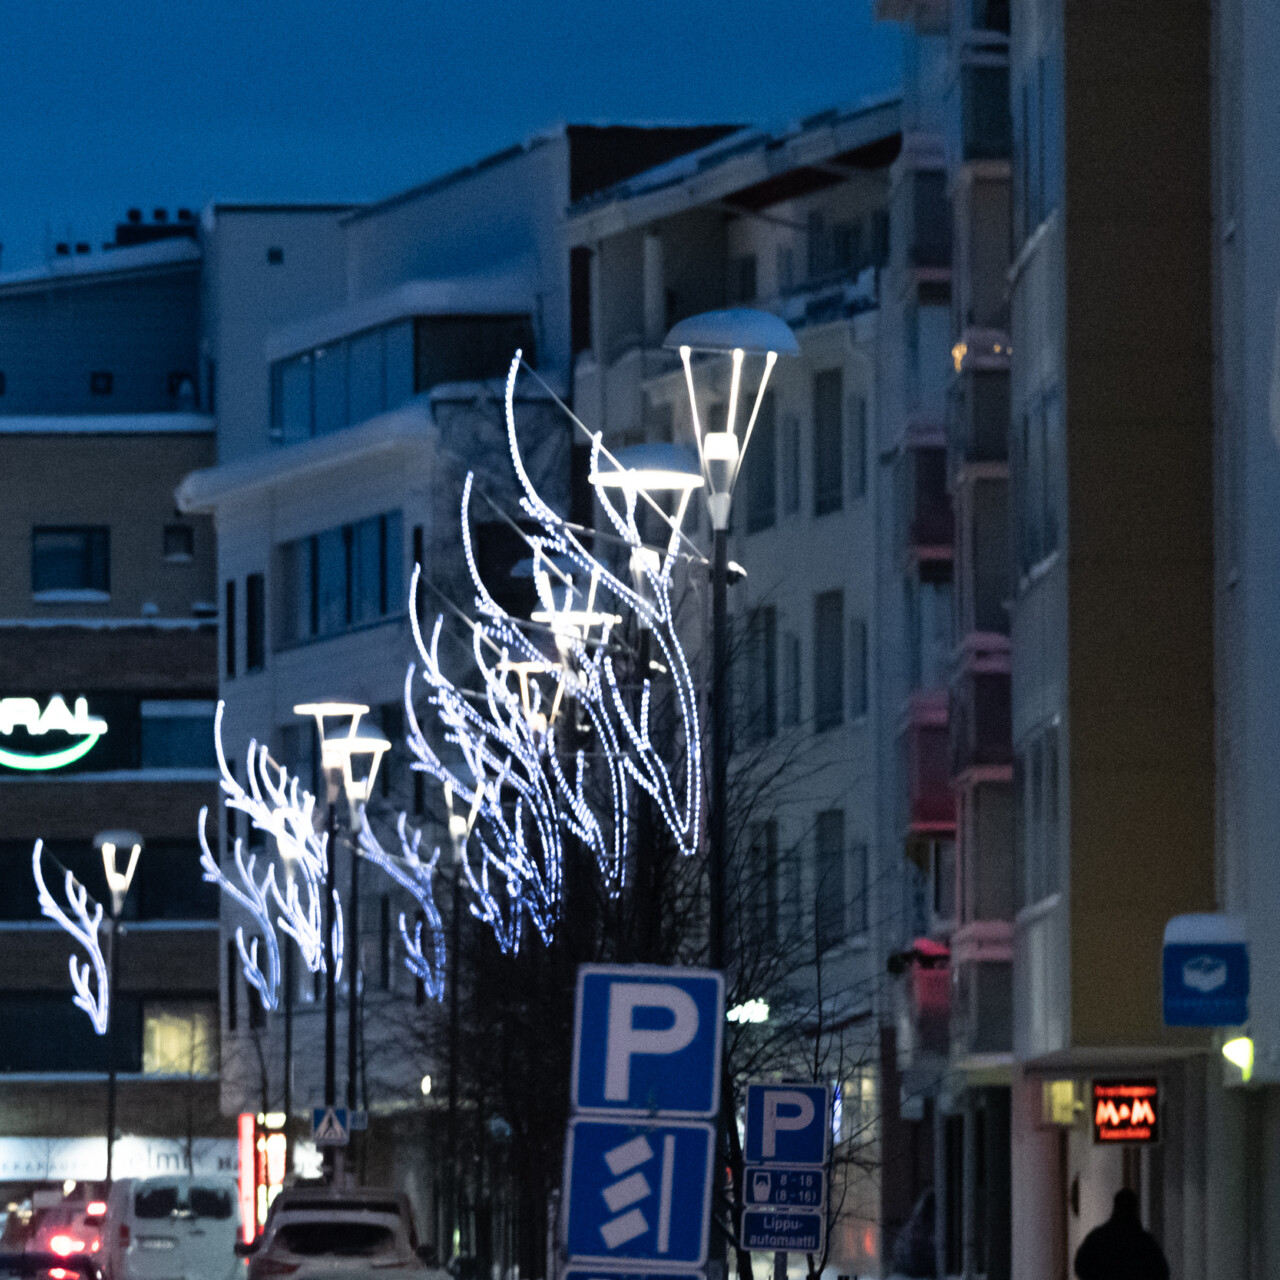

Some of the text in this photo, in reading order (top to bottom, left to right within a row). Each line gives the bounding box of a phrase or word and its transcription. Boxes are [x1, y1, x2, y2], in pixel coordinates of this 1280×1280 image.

[604, 982, 700, 1101] P
[762, 1090, 815, 1157] P
[749, 1234, 816, 1248] automaatti
[763, 1216, 804, 1233] Lippu-
